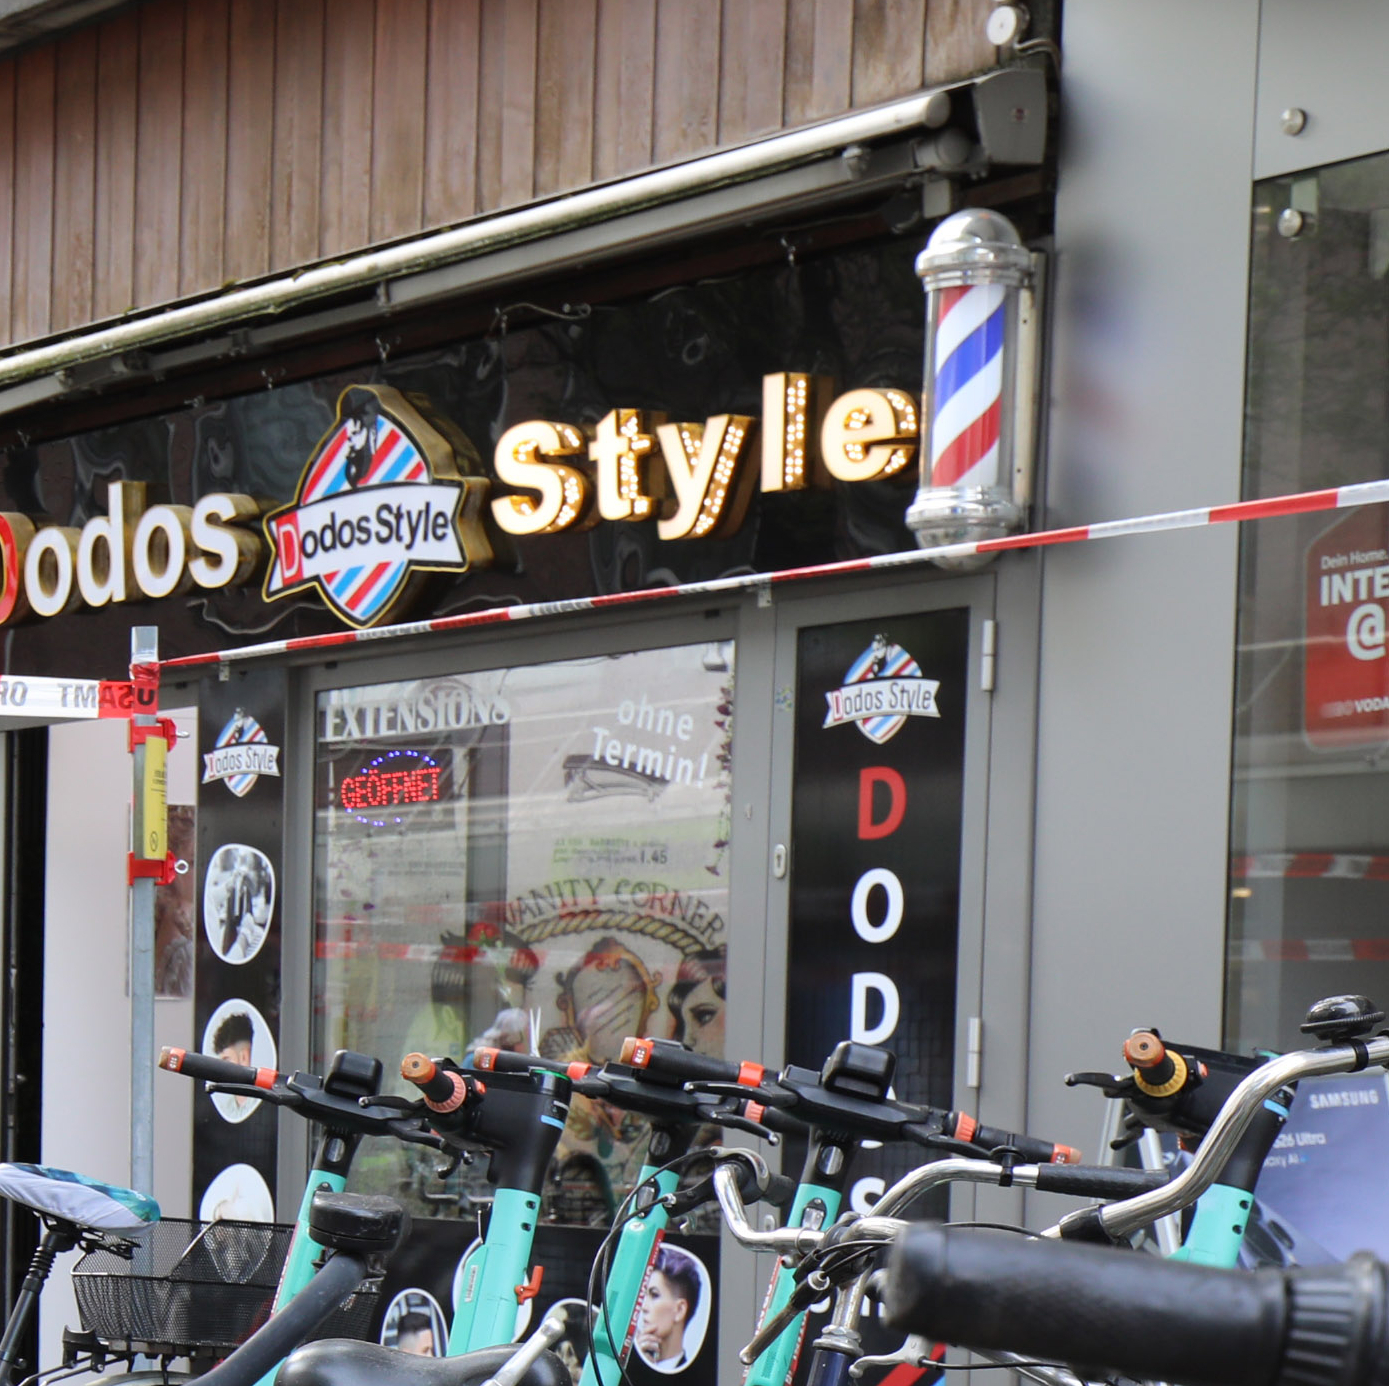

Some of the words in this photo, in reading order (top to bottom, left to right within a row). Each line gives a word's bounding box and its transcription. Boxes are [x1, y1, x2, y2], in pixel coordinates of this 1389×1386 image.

[1321, 554, 1348, 570] Dein
[887, 680, 933, 713] Style
[618, 694, 694, 741] ohne
[592, 727, 708, 788] Termin!
[340, 768, 442, 809] GEÖFFNET
[1308, 1089, 1381, 1110] SAMSUNG
